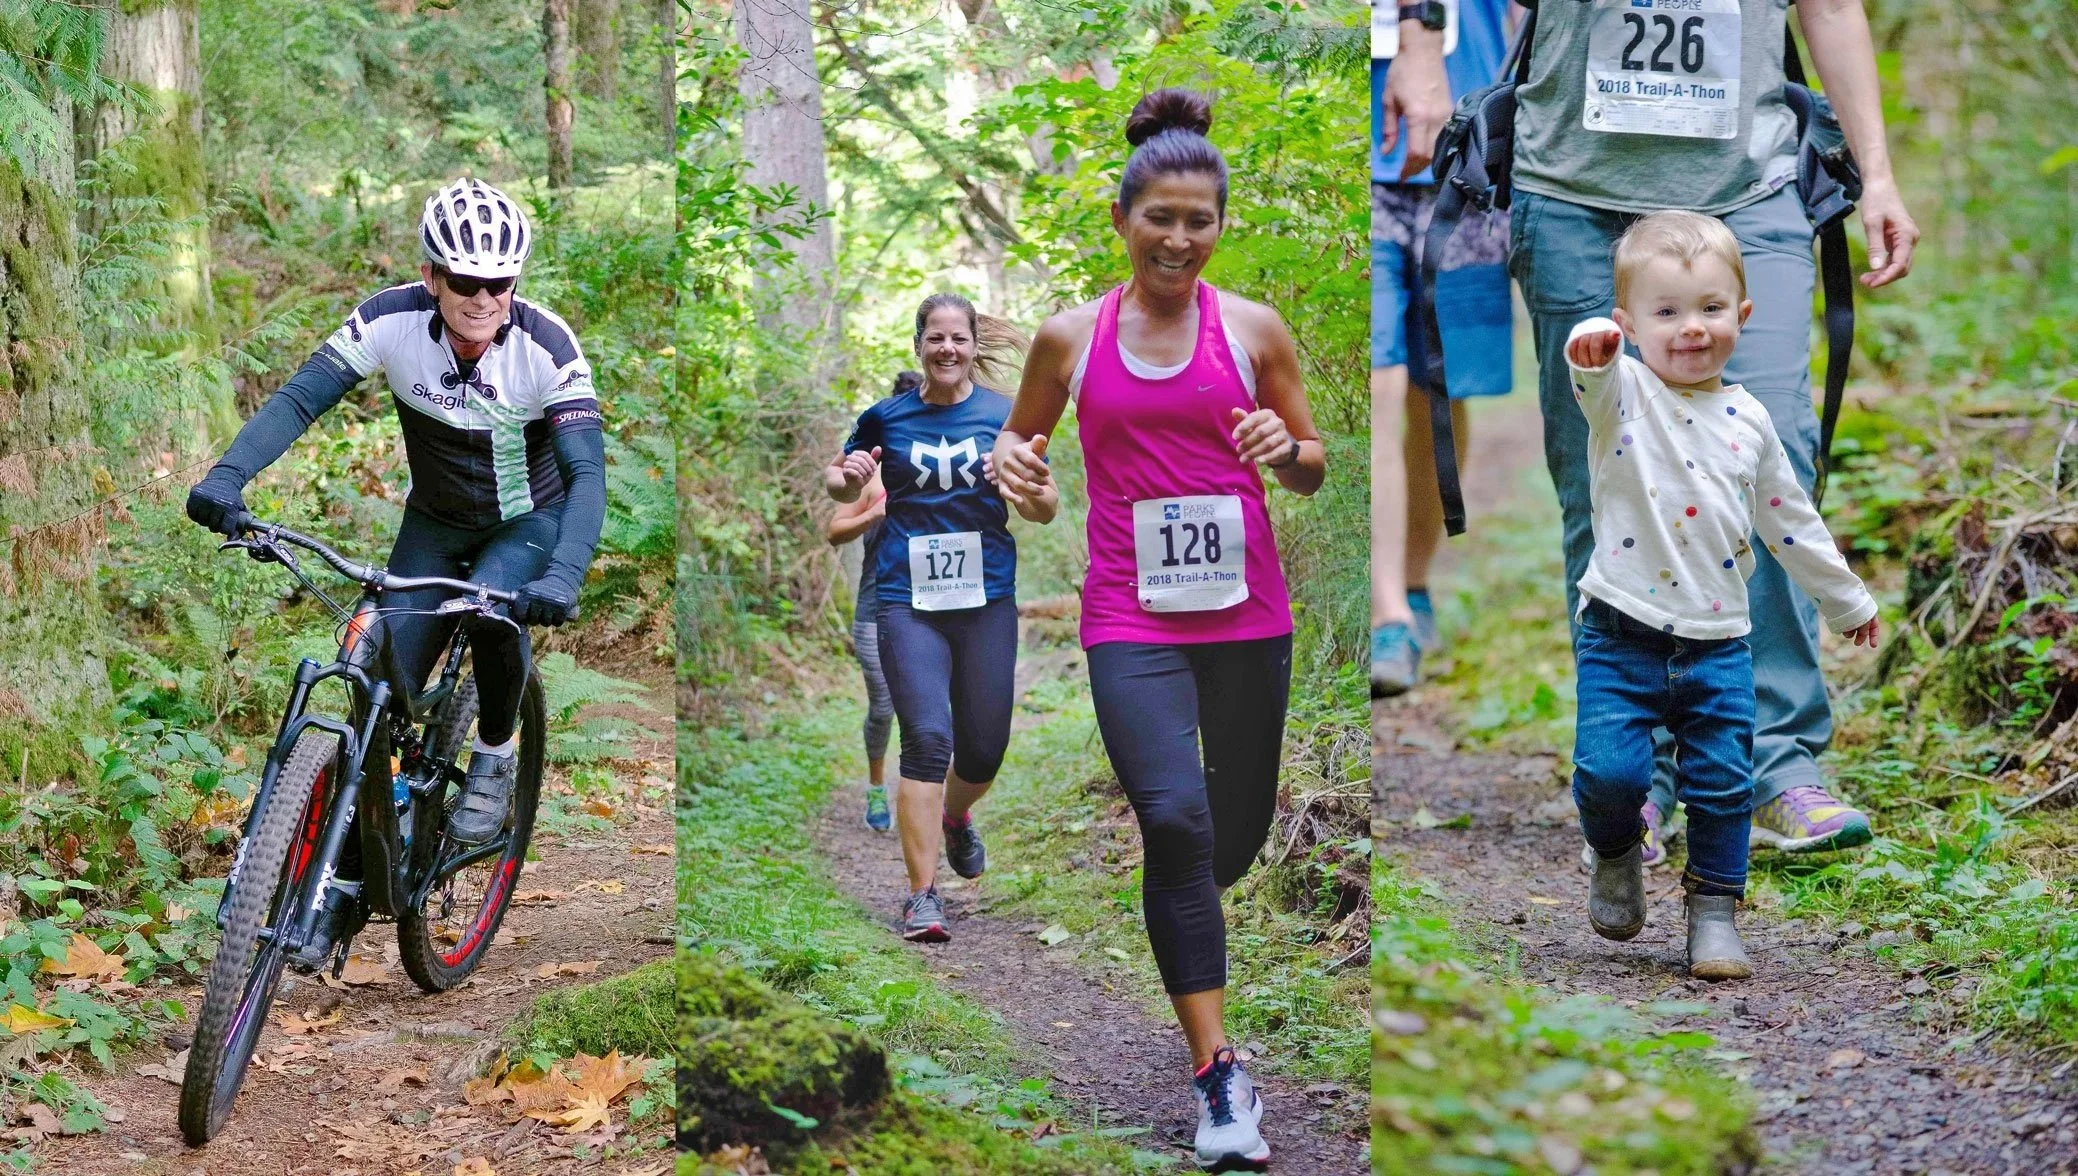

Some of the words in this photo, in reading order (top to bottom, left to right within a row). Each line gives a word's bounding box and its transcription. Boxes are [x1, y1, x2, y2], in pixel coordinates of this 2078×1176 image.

[1657, 0, 1702, 10] PEOPLE
[1621, 12, 1705, 74] 226
[1598, 79, 1630, 94] 2018
[1636, 81, 1726, 99] Trail-A-Thon
[411, 383, 466, 411] Skagit
[1183, 504, 1216, 514] PARKS
[1159, 521, 1222, 567] 128
[925, 549, 966, 581] 127
[918, 584, 935, 593] 2018
[1147, 574, 1172, 586] 2018
[1175, 571, 1238, 584] Trail-A-Thon
[310, 861, 338, 912] FOX
